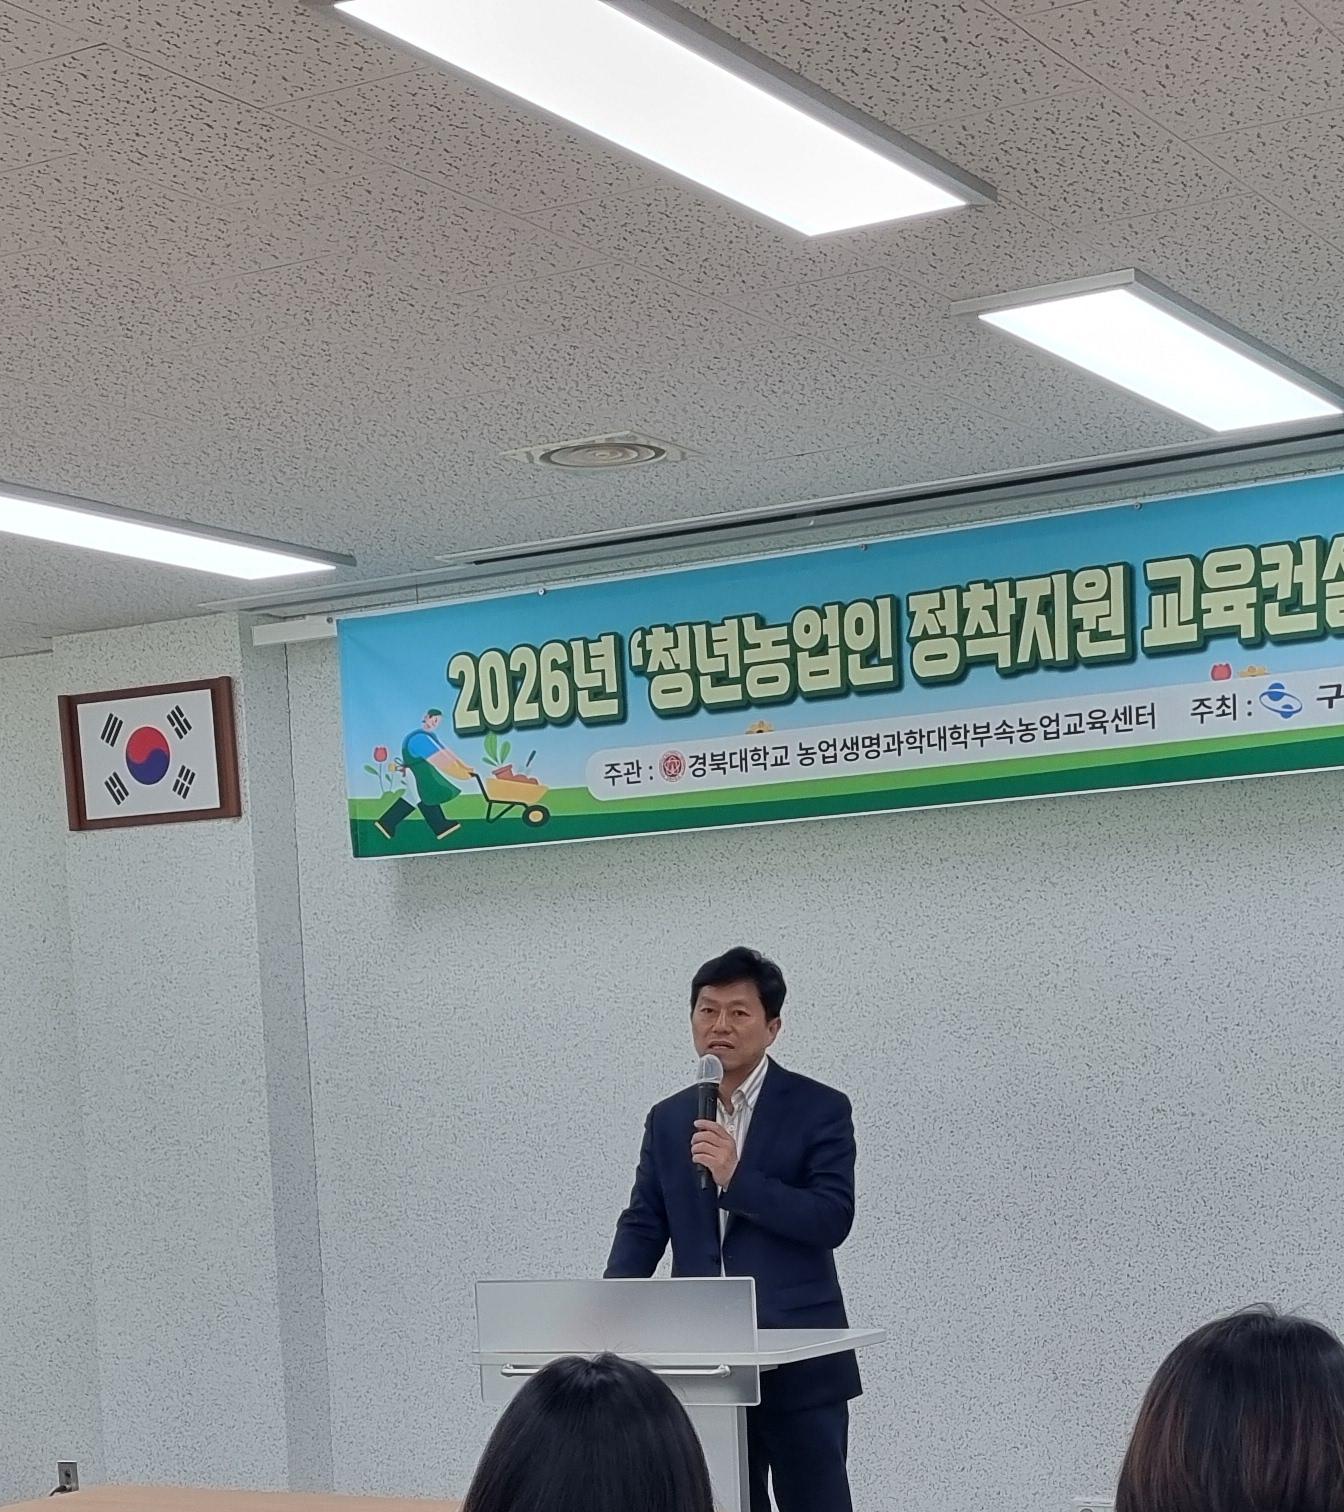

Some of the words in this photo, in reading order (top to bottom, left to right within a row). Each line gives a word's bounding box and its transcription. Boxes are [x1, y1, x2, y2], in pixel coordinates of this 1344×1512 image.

[450, 635, 621, 732] 2026년
[908, 563, 1125, 679] 정착지원
[603, 760, 642, 786] 주관
[687, 744, 791, 779] 경북대학교
[796, 702, 1157, 767] 농업생명과학대학부속농업교육센터
[1190, 694, 1239, 723] 주최
